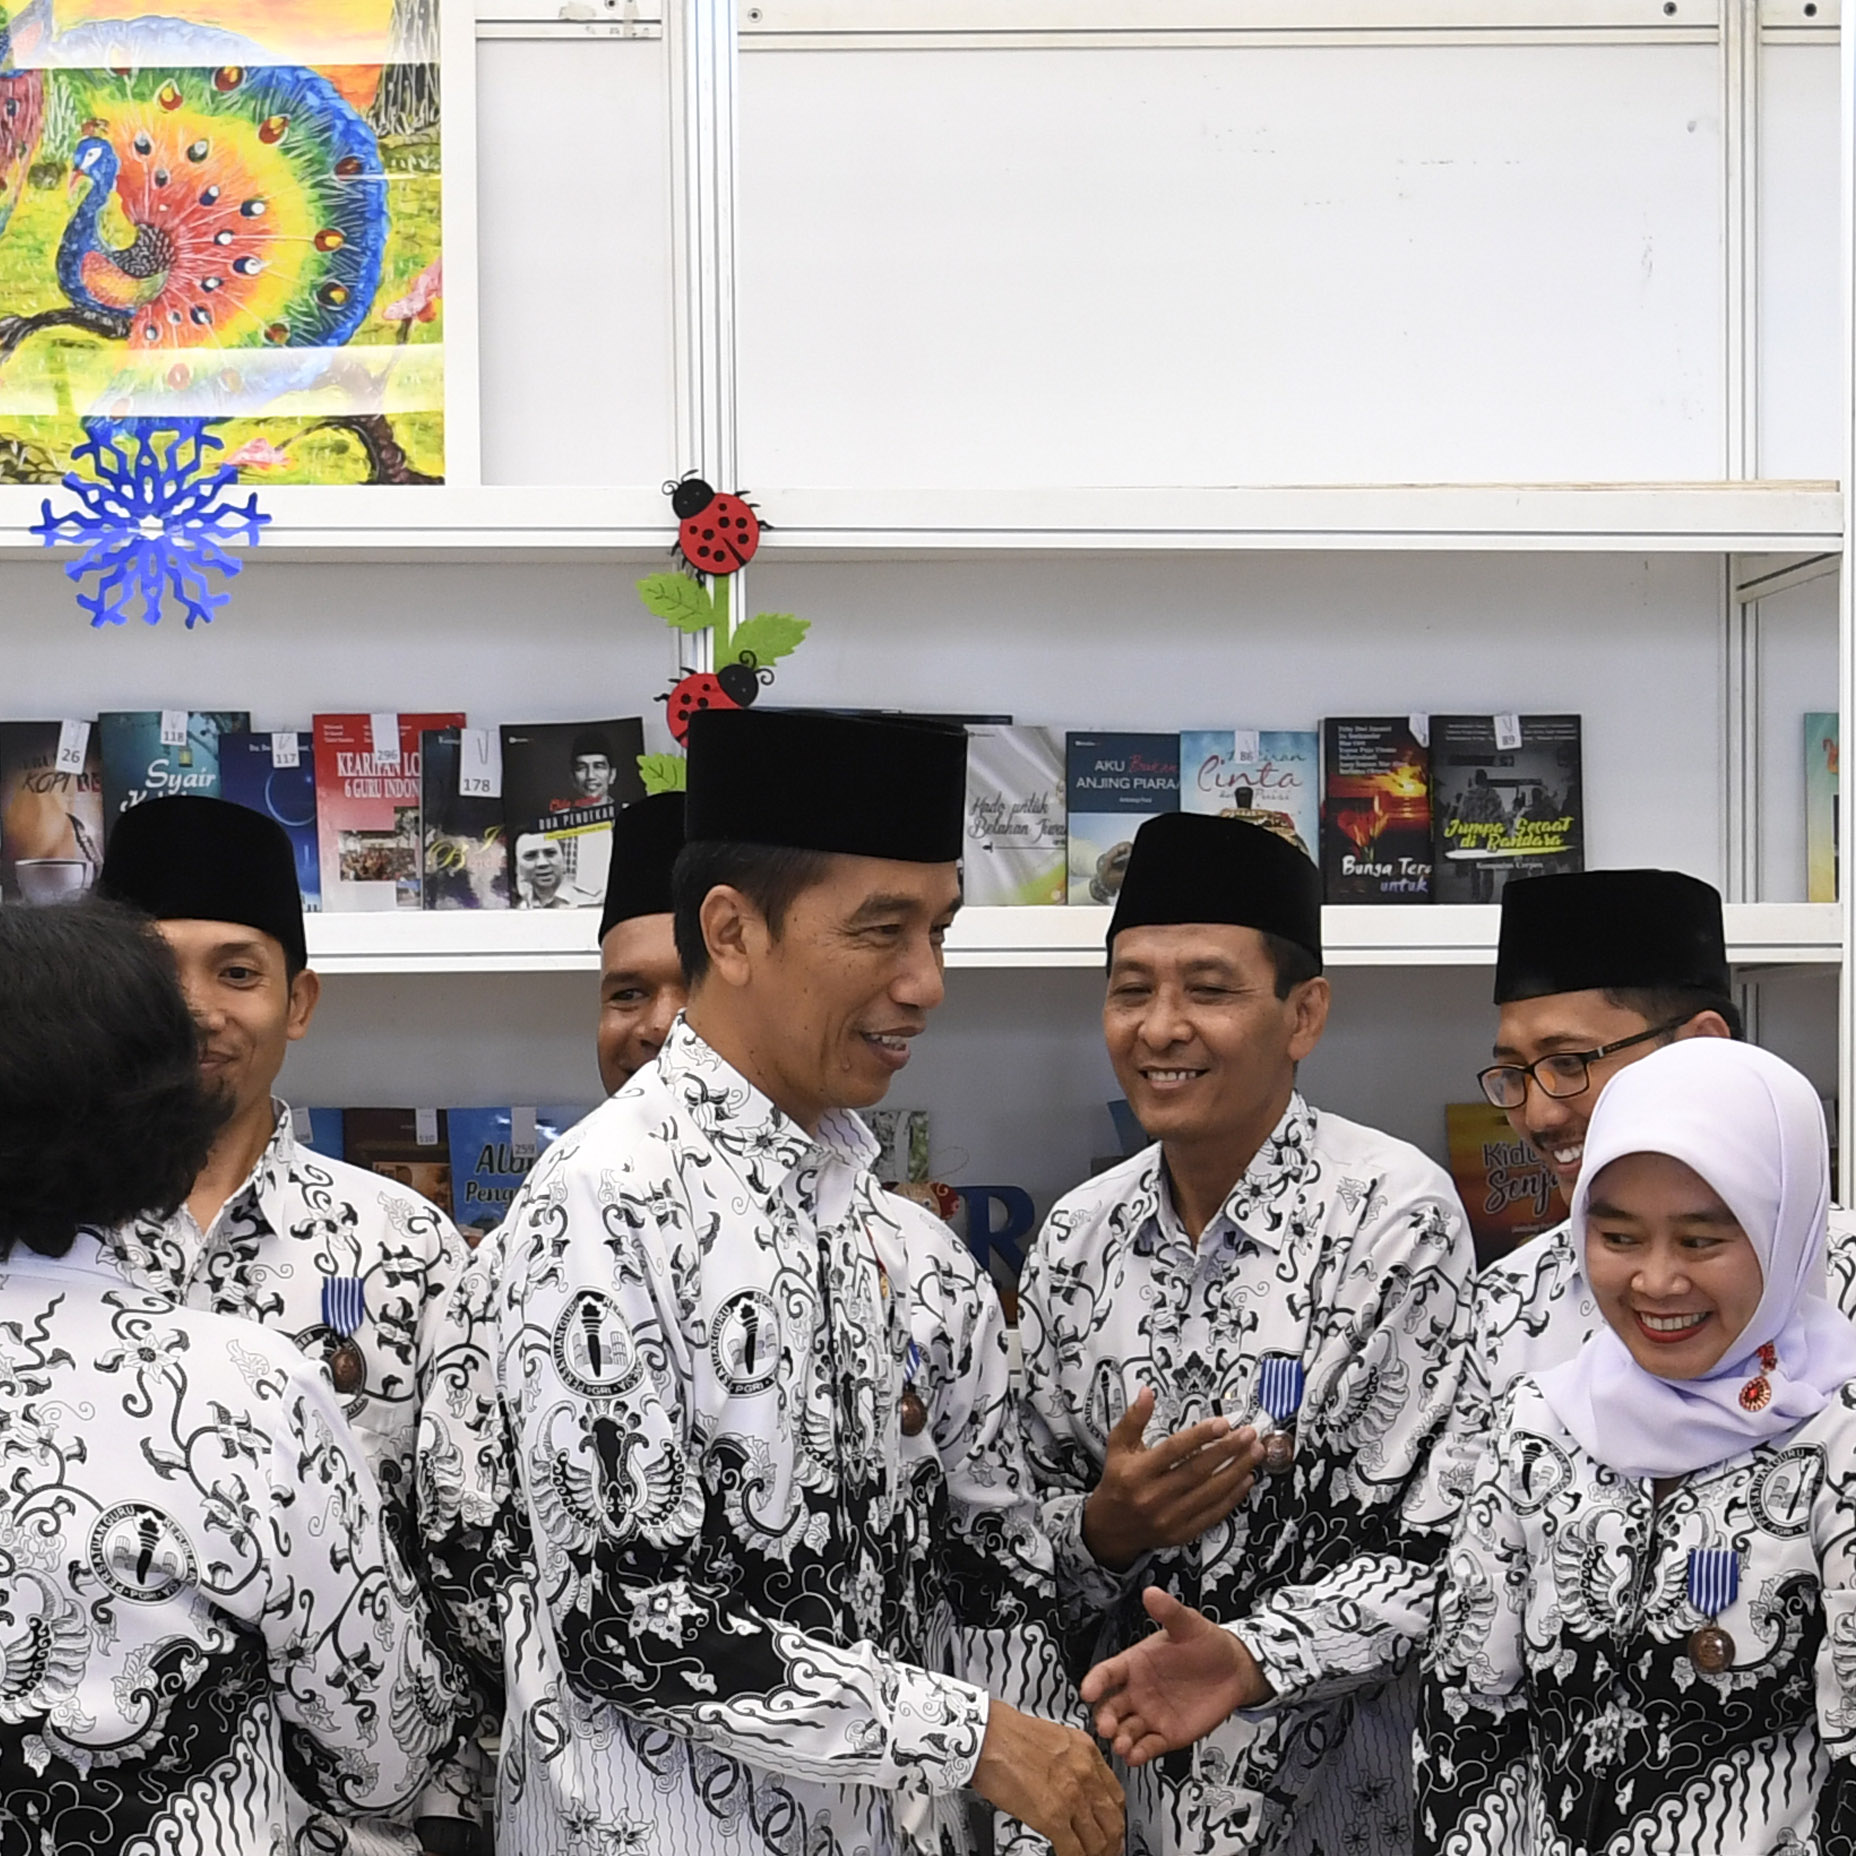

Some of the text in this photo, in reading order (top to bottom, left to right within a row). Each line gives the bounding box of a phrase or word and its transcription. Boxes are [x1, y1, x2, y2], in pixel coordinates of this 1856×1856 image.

[61, 748, 80, 763] 26
[275, 753, 296, 765] 117
[1094, 759, 1126, 772] AKU
[1197, 754, 1303, 792] Cinta
[144, 758, 217, 791] Syair
[1075, 776, 1131, 790] ANJING
[463, 778, 491, 793] 178
[1444, 818, 1505, 839] Jumpa
[1460, 834, 1563, 853] di Bandara
[1341, 855, 1393, 878] Bunga
[1380, 878, 1430, 894] untuk
[735, 1382, 765, 1394] PGRI
[104, 1505, 138, 1528] GURU
[90, 1522, 129, 1597] PERSATUAN
